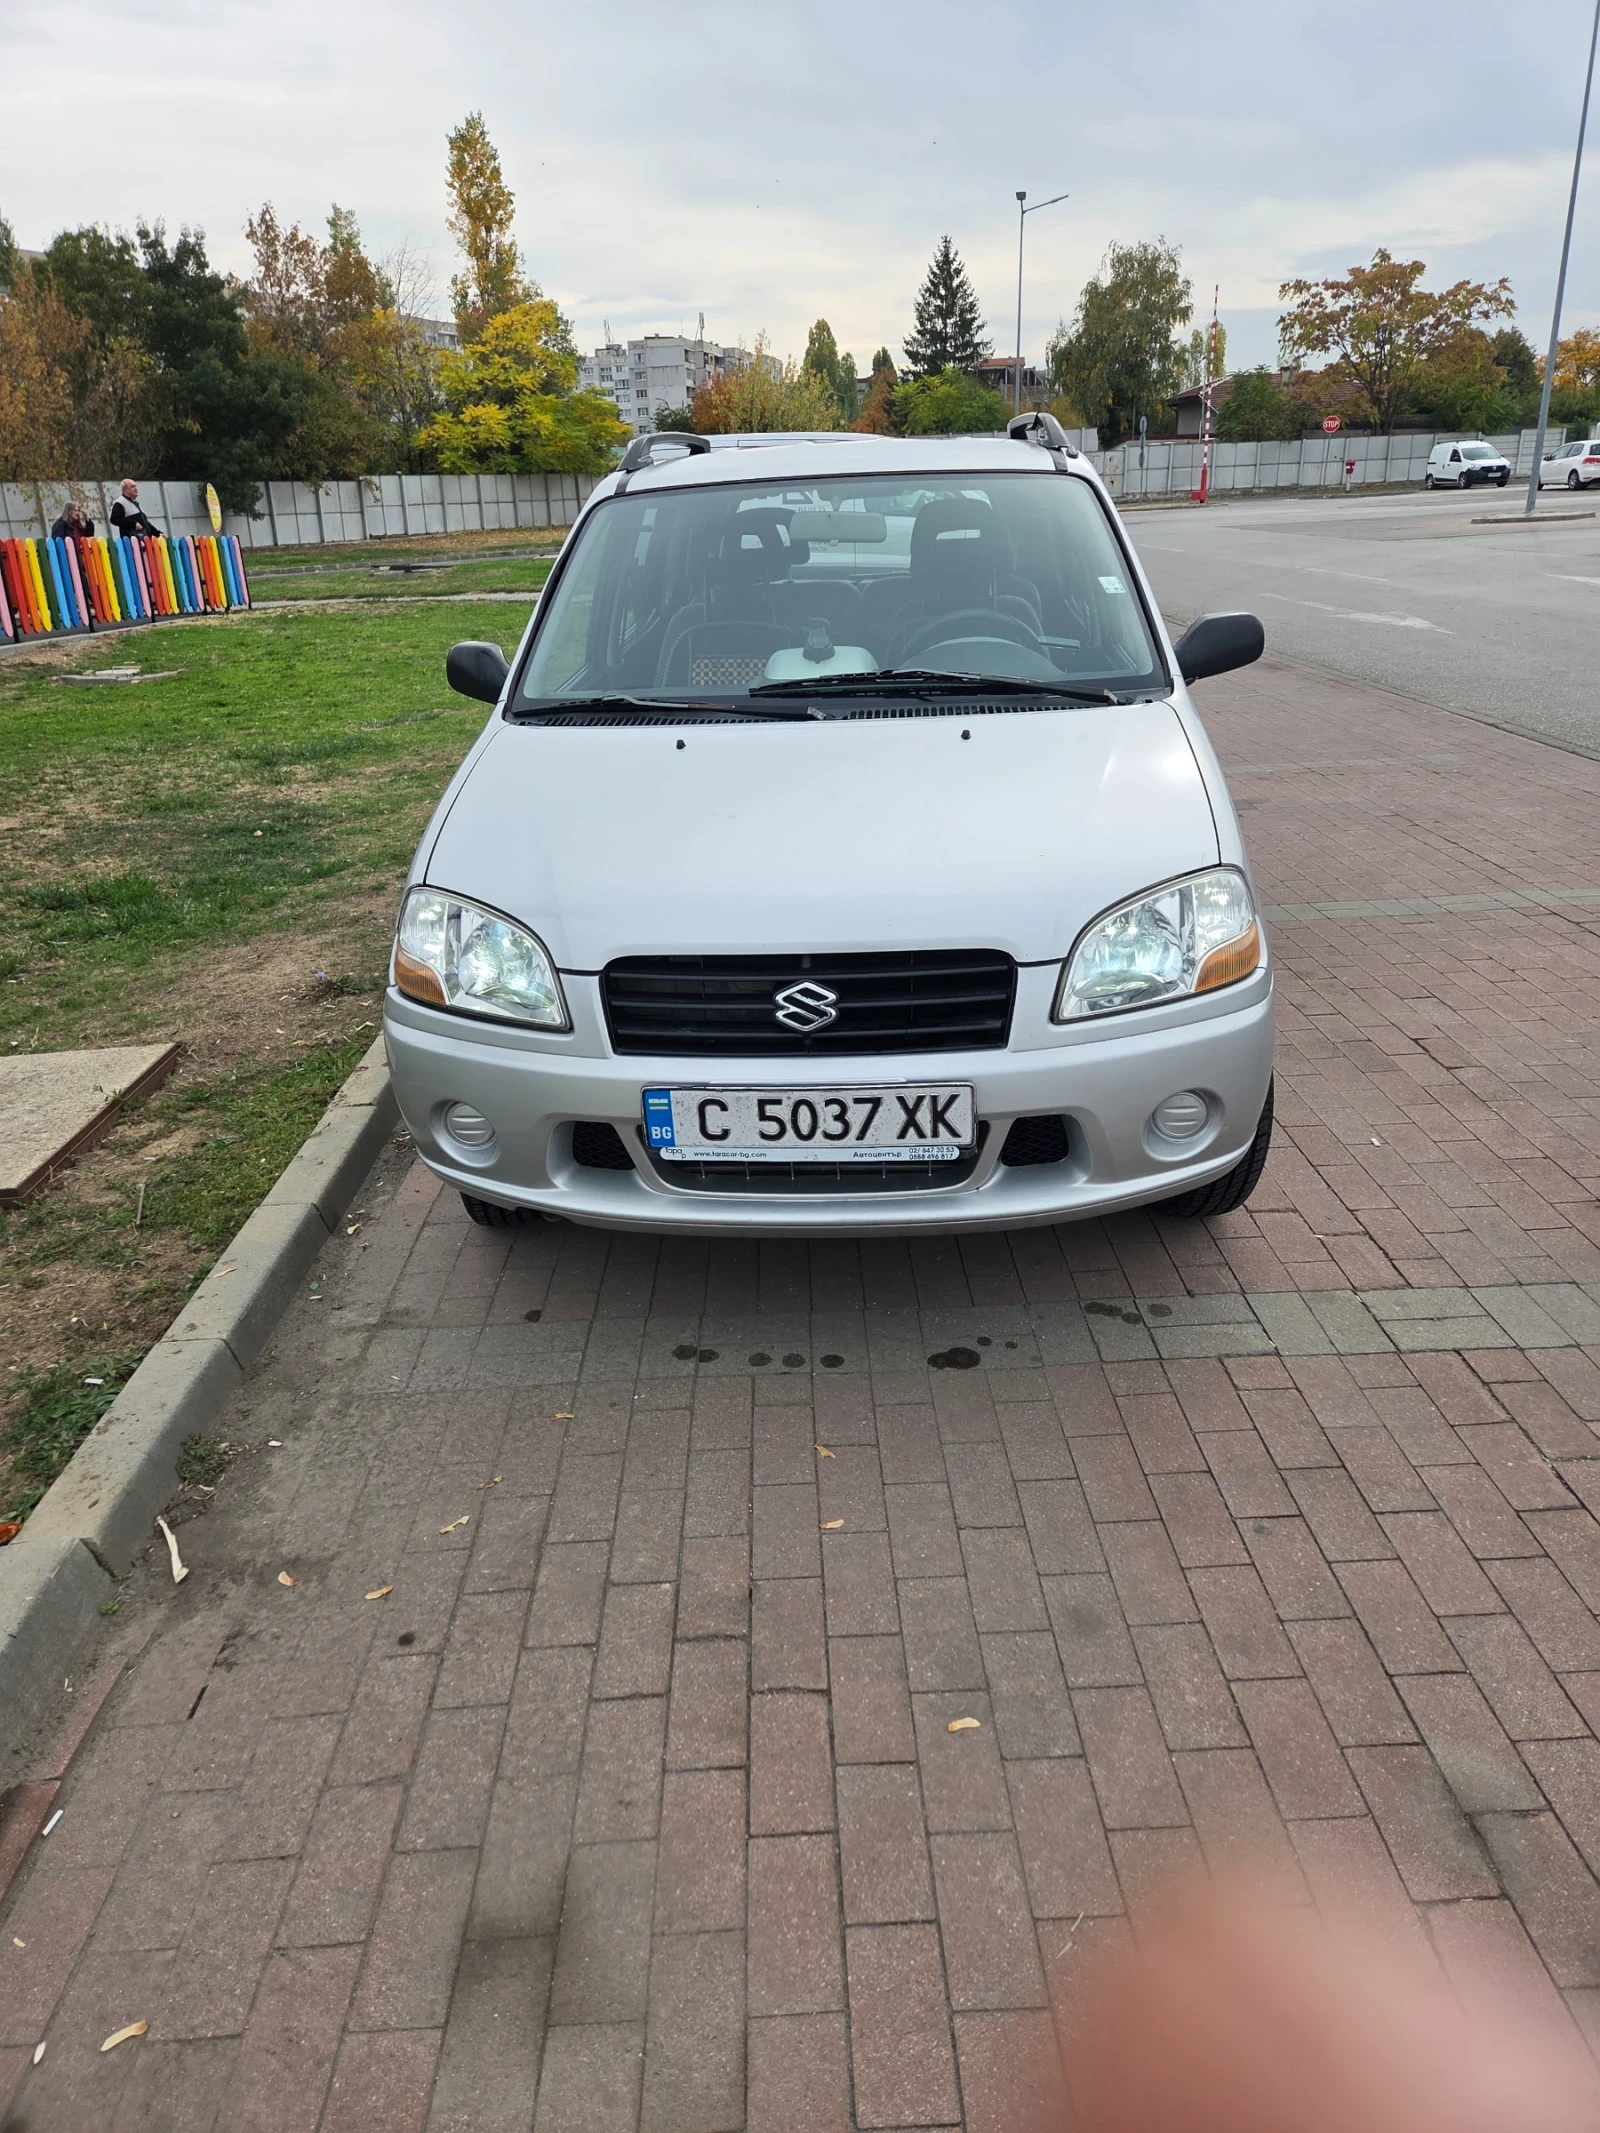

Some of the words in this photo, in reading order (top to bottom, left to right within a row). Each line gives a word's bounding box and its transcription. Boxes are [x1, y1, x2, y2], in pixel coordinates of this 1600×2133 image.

[697, 1097, 731, 1141] C
[757, 1097, 883, 1141] 5037
[895, 1094, 963, 1139] XK
[651, 1126, 672, 1139] BG
[693, 1151, 767, 1159] www.taracar-bg.com
